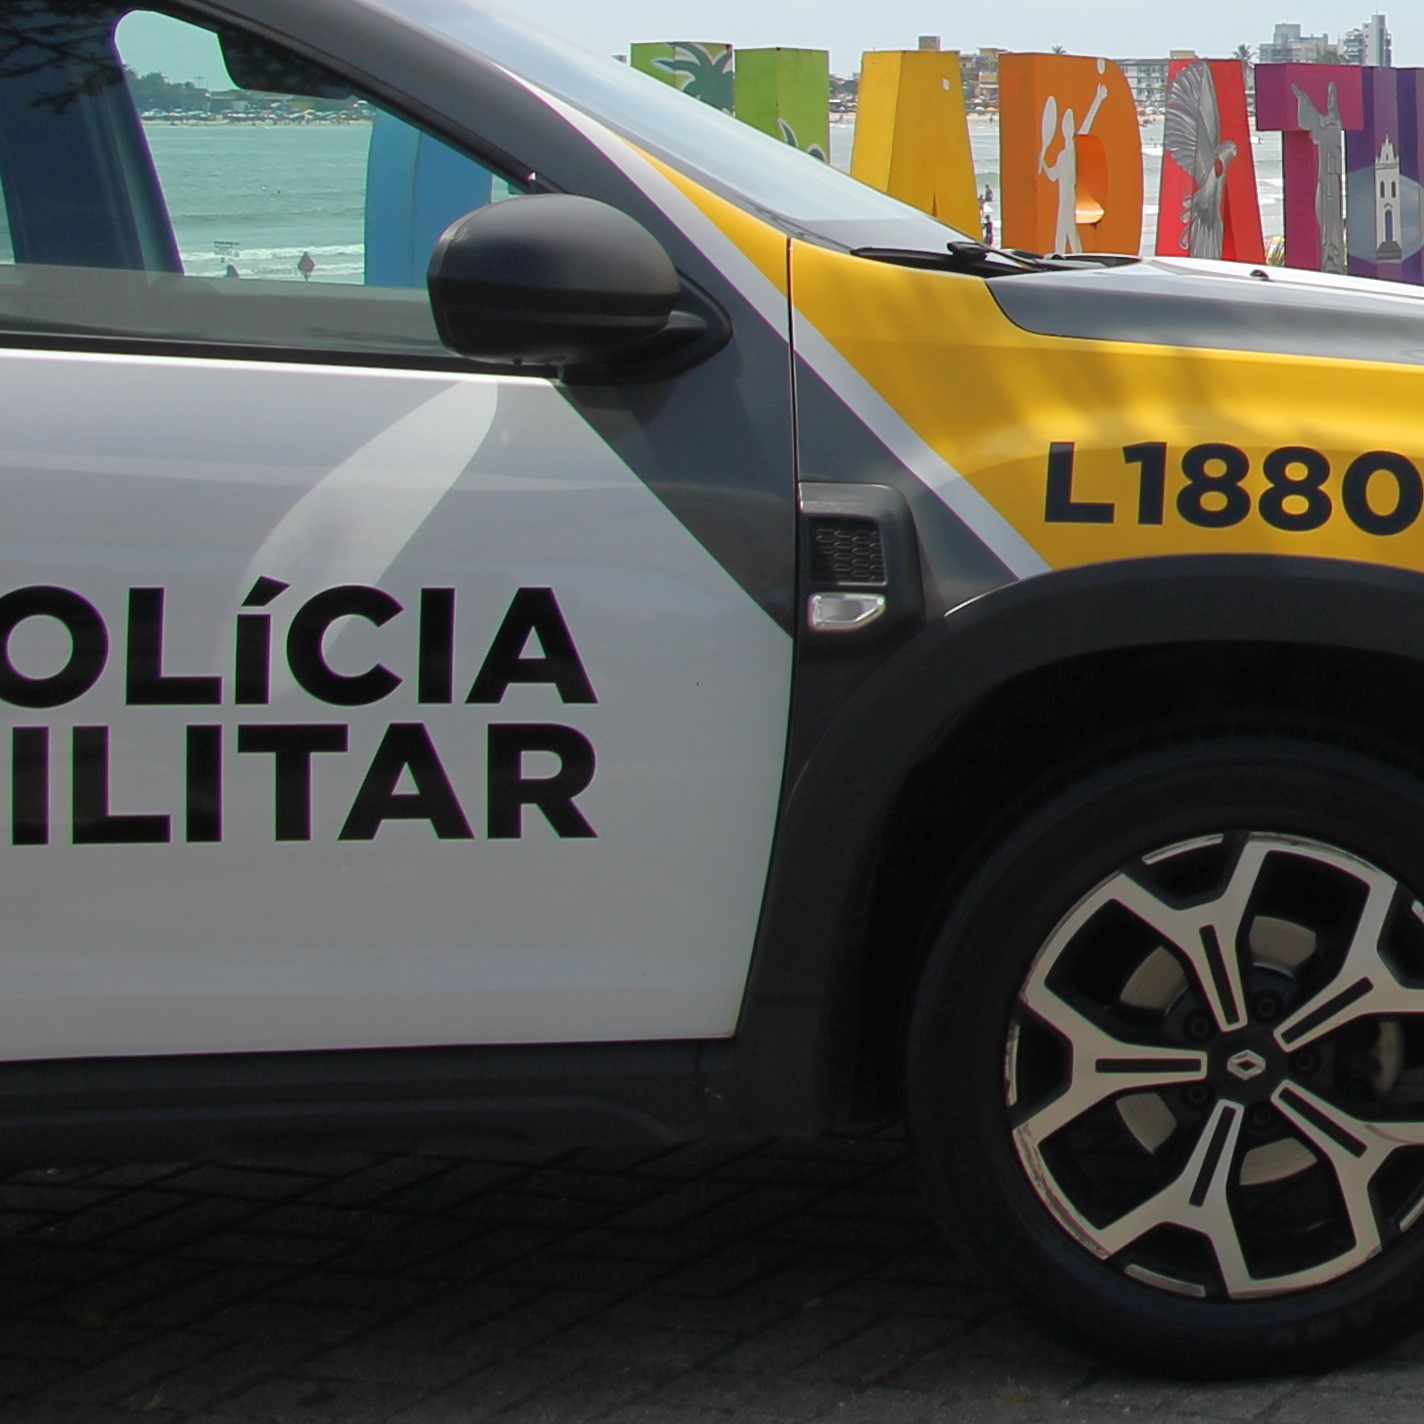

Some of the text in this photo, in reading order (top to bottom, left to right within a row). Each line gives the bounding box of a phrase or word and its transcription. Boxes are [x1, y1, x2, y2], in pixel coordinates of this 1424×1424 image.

[1044, 440, 1424, 538] L1880
[0, 575, 599, 709] OLÍCIA
[11, 721, 599, 846] ILITAR
